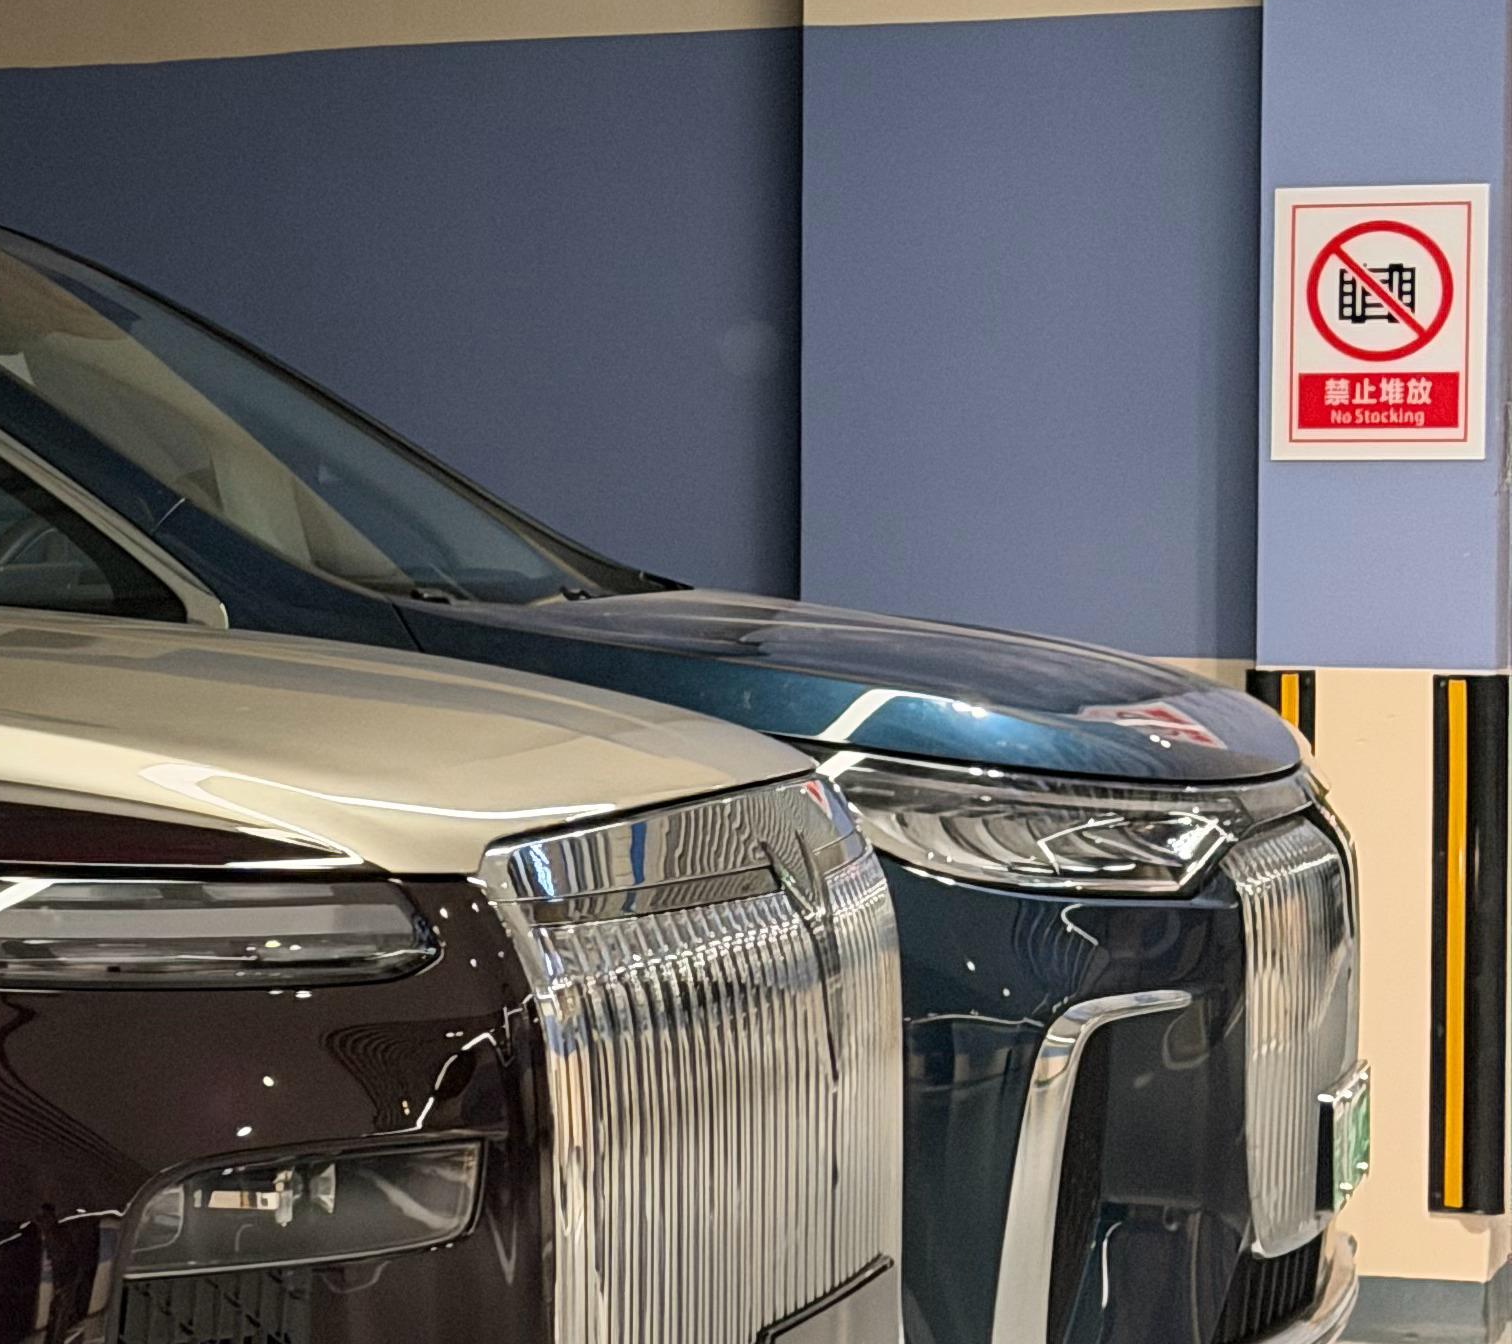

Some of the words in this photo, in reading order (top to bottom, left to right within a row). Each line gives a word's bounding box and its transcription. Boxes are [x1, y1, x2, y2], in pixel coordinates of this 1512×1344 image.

[1324, 377, 1433, 405] 禁止堆放
[1330, 409, 1352, 424] No
[1355, 408, 1425, 427] Stocking
